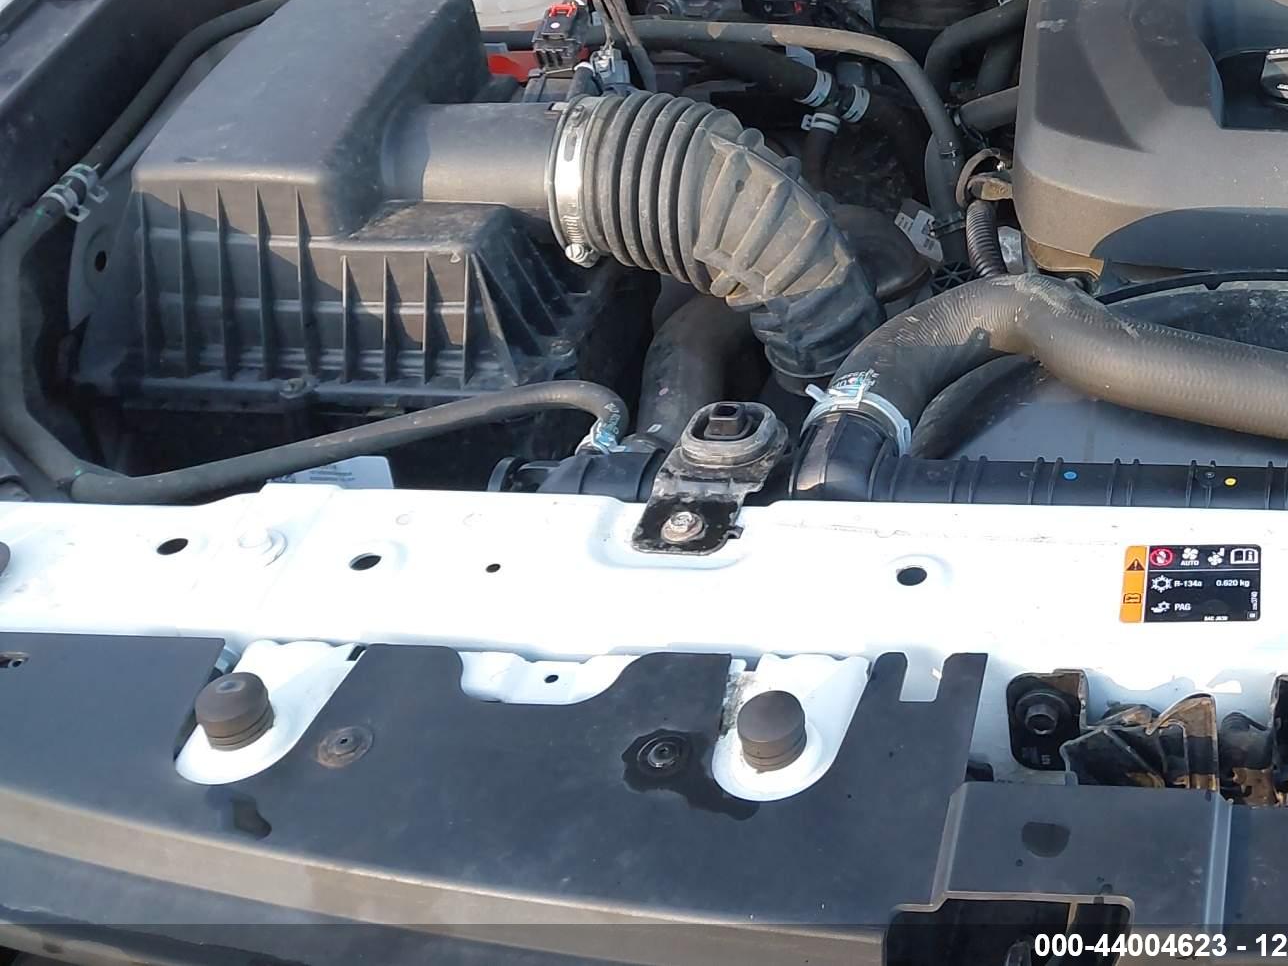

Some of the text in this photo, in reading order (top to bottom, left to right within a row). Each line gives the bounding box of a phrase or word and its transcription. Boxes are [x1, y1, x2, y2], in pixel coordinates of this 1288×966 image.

[1173, 579, 1251, 588] R-134a 0.620 kg
[1174, 603, 1192, 611] PAG
